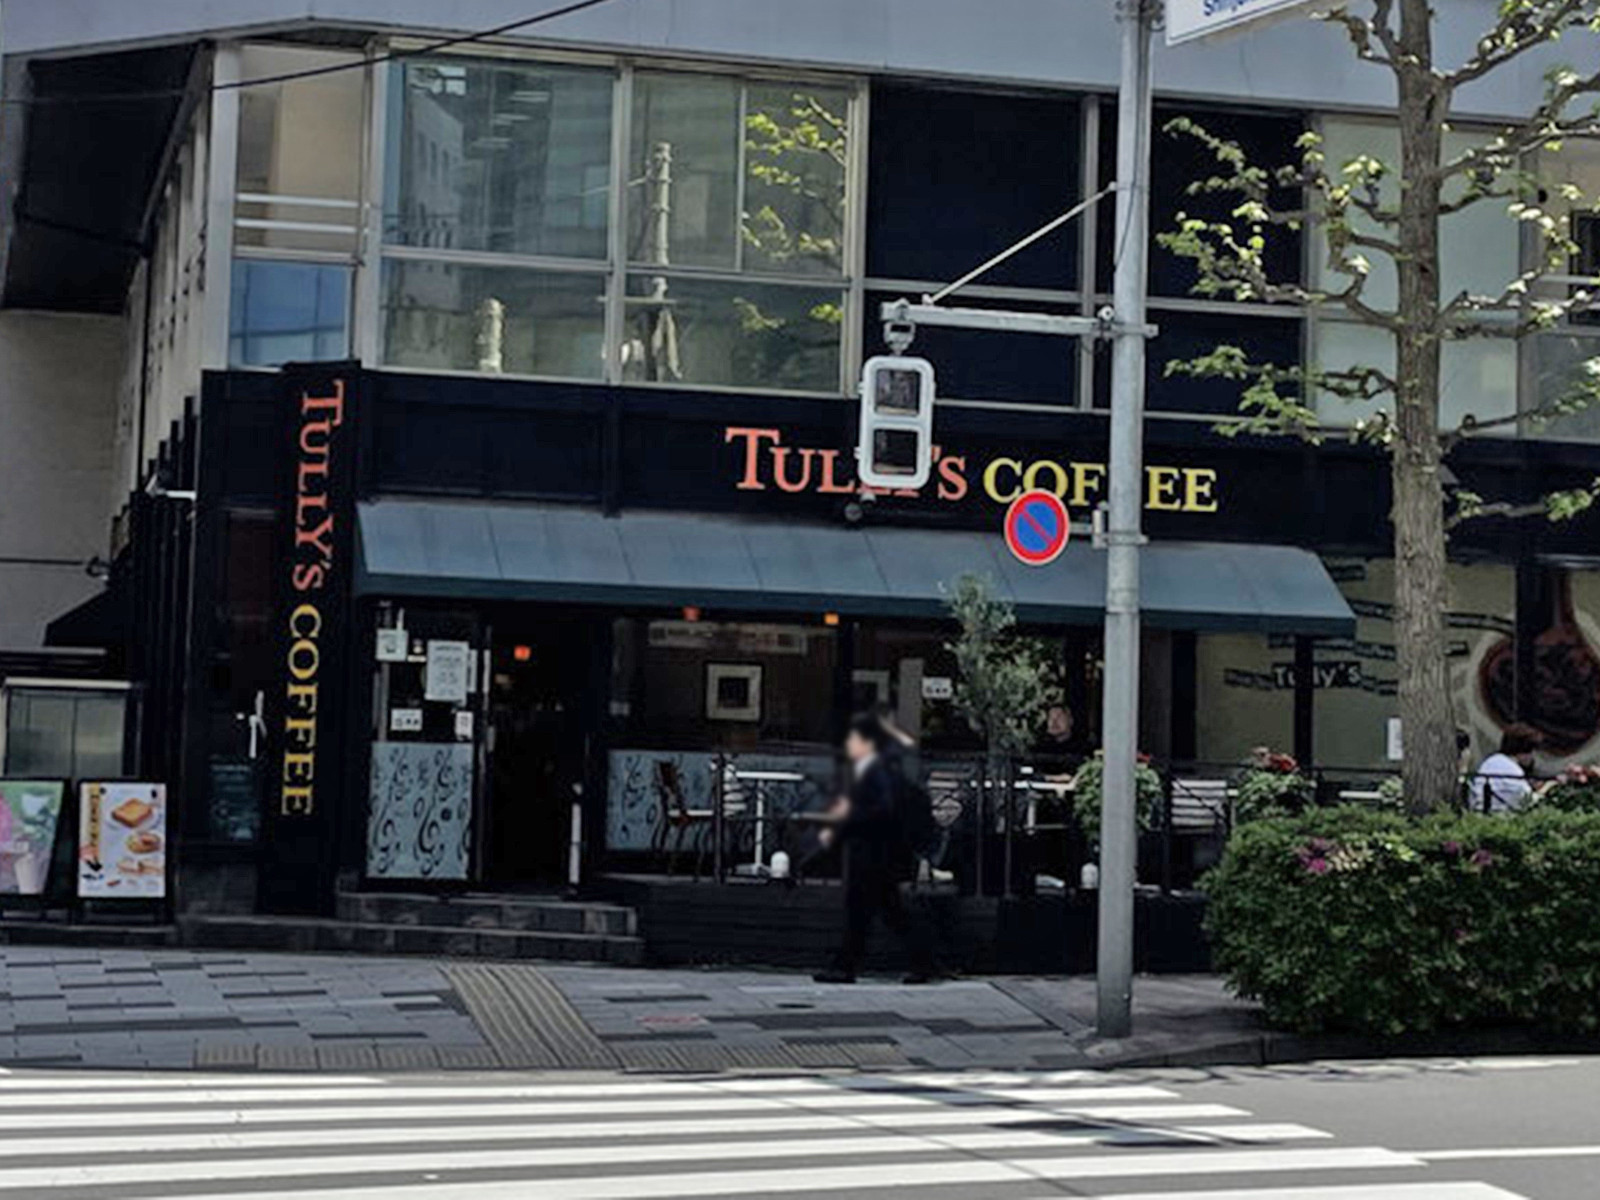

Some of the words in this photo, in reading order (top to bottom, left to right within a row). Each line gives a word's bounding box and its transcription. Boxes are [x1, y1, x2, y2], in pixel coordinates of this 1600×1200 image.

[292, 379, 344, 590] TULLY'S
[725, 427, 967, 500] TUL'S
[983, 457, 1218, 512] COFEE
[281, 604, 321, 815] COFFEE
[1274, 662, 1361, 688] Tuly's
